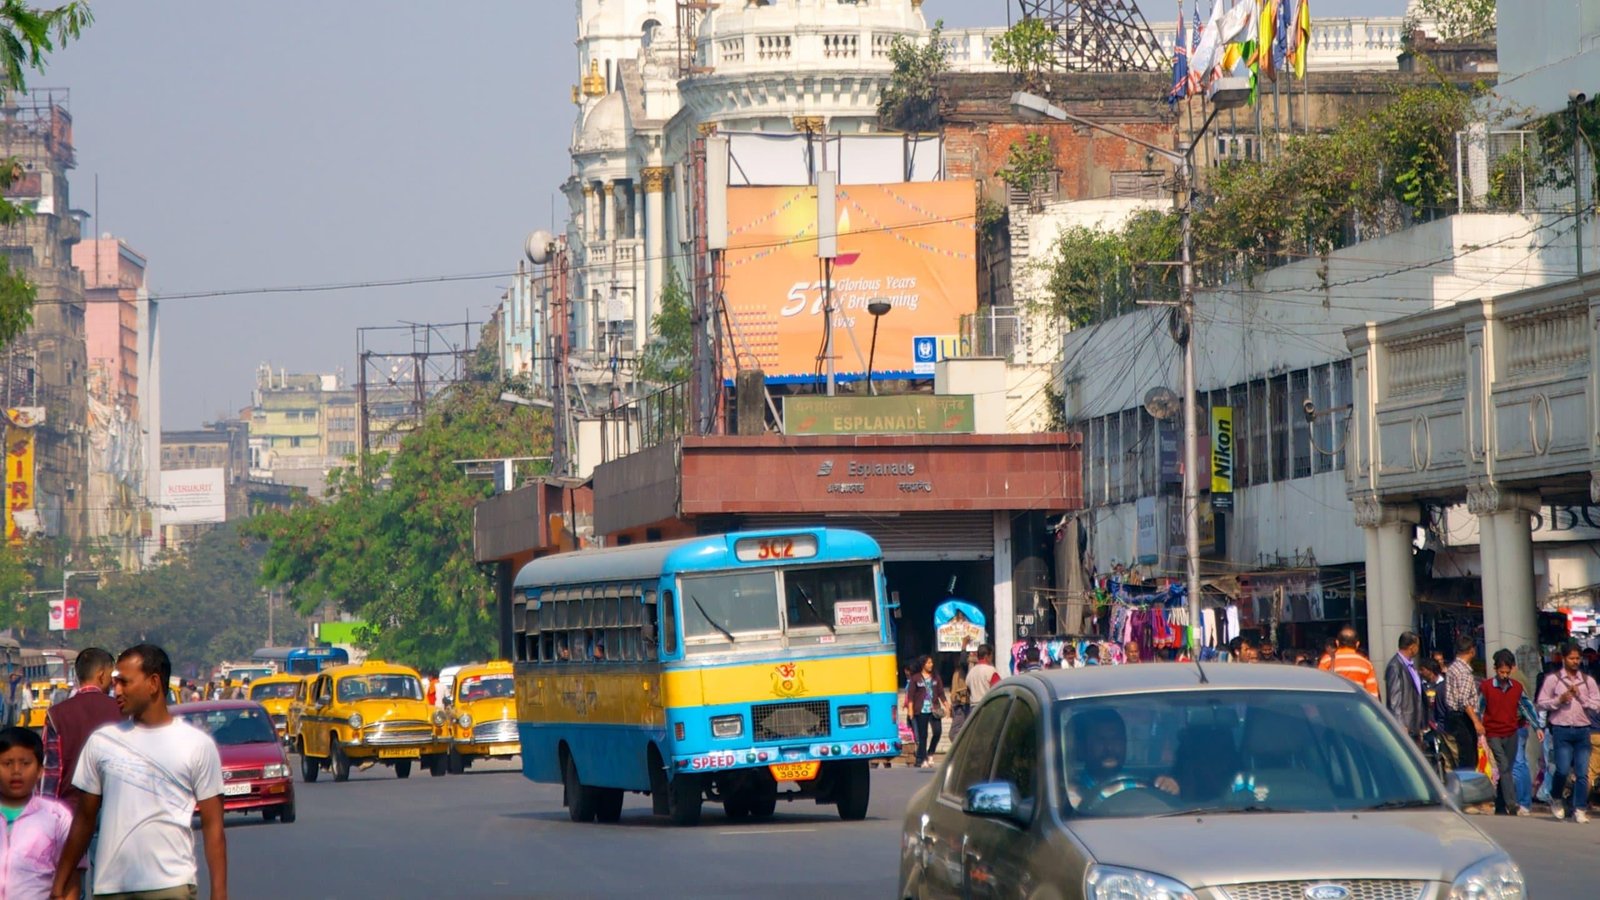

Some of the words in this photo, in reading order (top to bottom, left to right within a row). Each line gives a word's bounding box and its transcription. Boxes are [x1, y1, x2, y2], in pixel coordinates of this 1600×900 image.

[836, 278, 881, 292] Glorious
[886, 276, 917, 289] Years
[780, 281, 836, 317] 57
[848, 292, 919, 311] Brigning
[833, 416, 927, 431] ESPLANADE
[1214, 419, 1231, 480] Nikon
[848, 461, 915, 477] Esplanade
[758, 539, 794, 559] 3C2
[692, 754, 735, 770] SPEED
